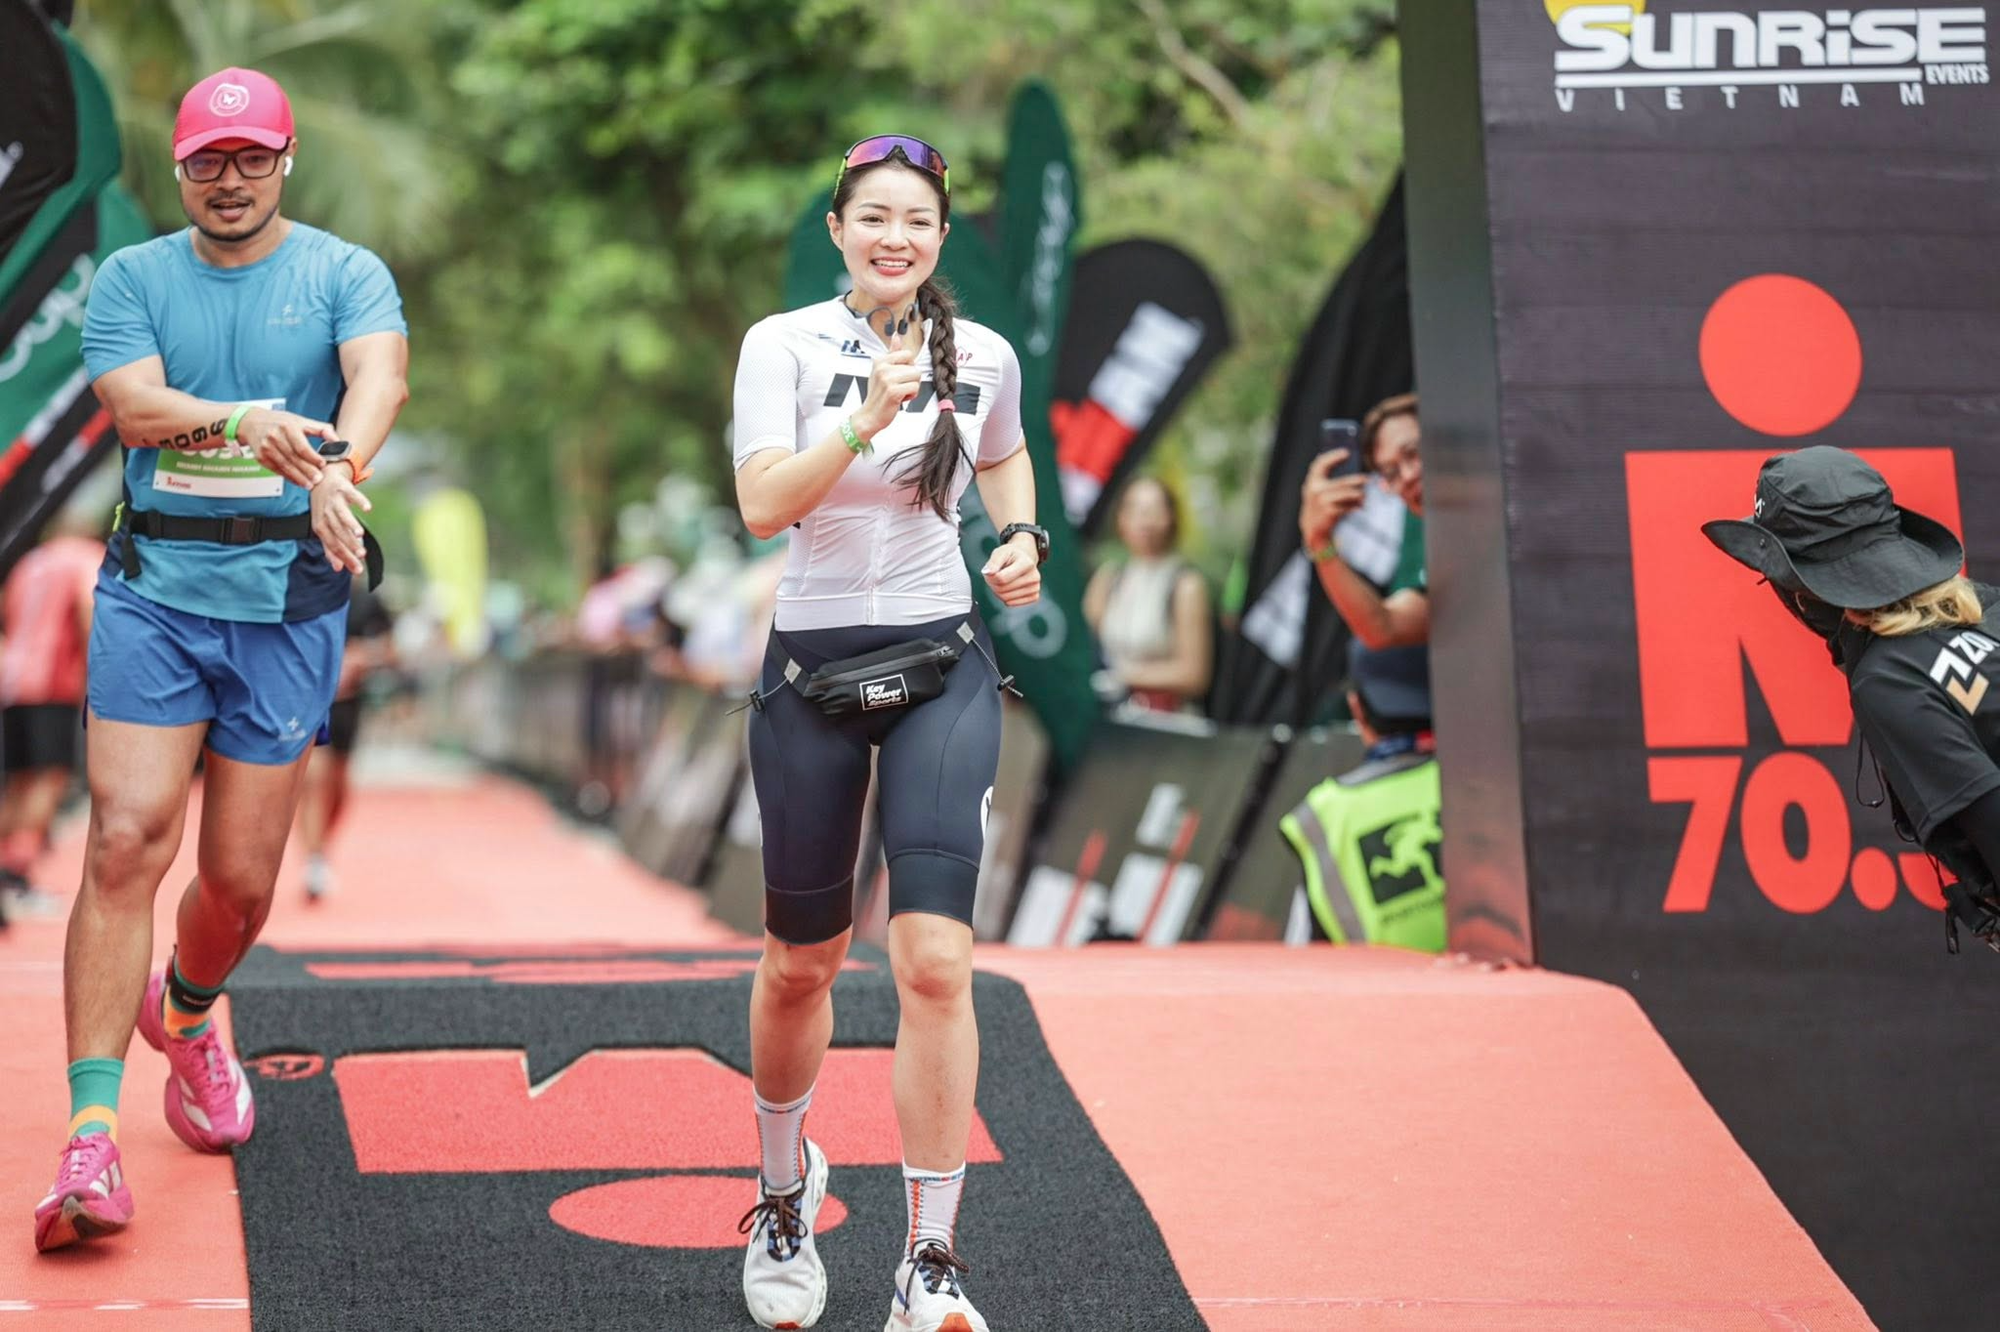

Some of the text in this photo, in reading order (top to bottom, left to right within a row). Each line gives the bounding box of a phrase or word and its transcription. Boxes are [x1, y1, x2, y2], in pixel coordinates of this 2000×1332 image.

[1925, 63, 1990, 84] EVENTS
[1555, 82, 1925, 112] VIETNAM
[1948, 631, 2000, 665] ZO
[866, 684, 885, 695] Key
[867, 688, 902, 702] Power
